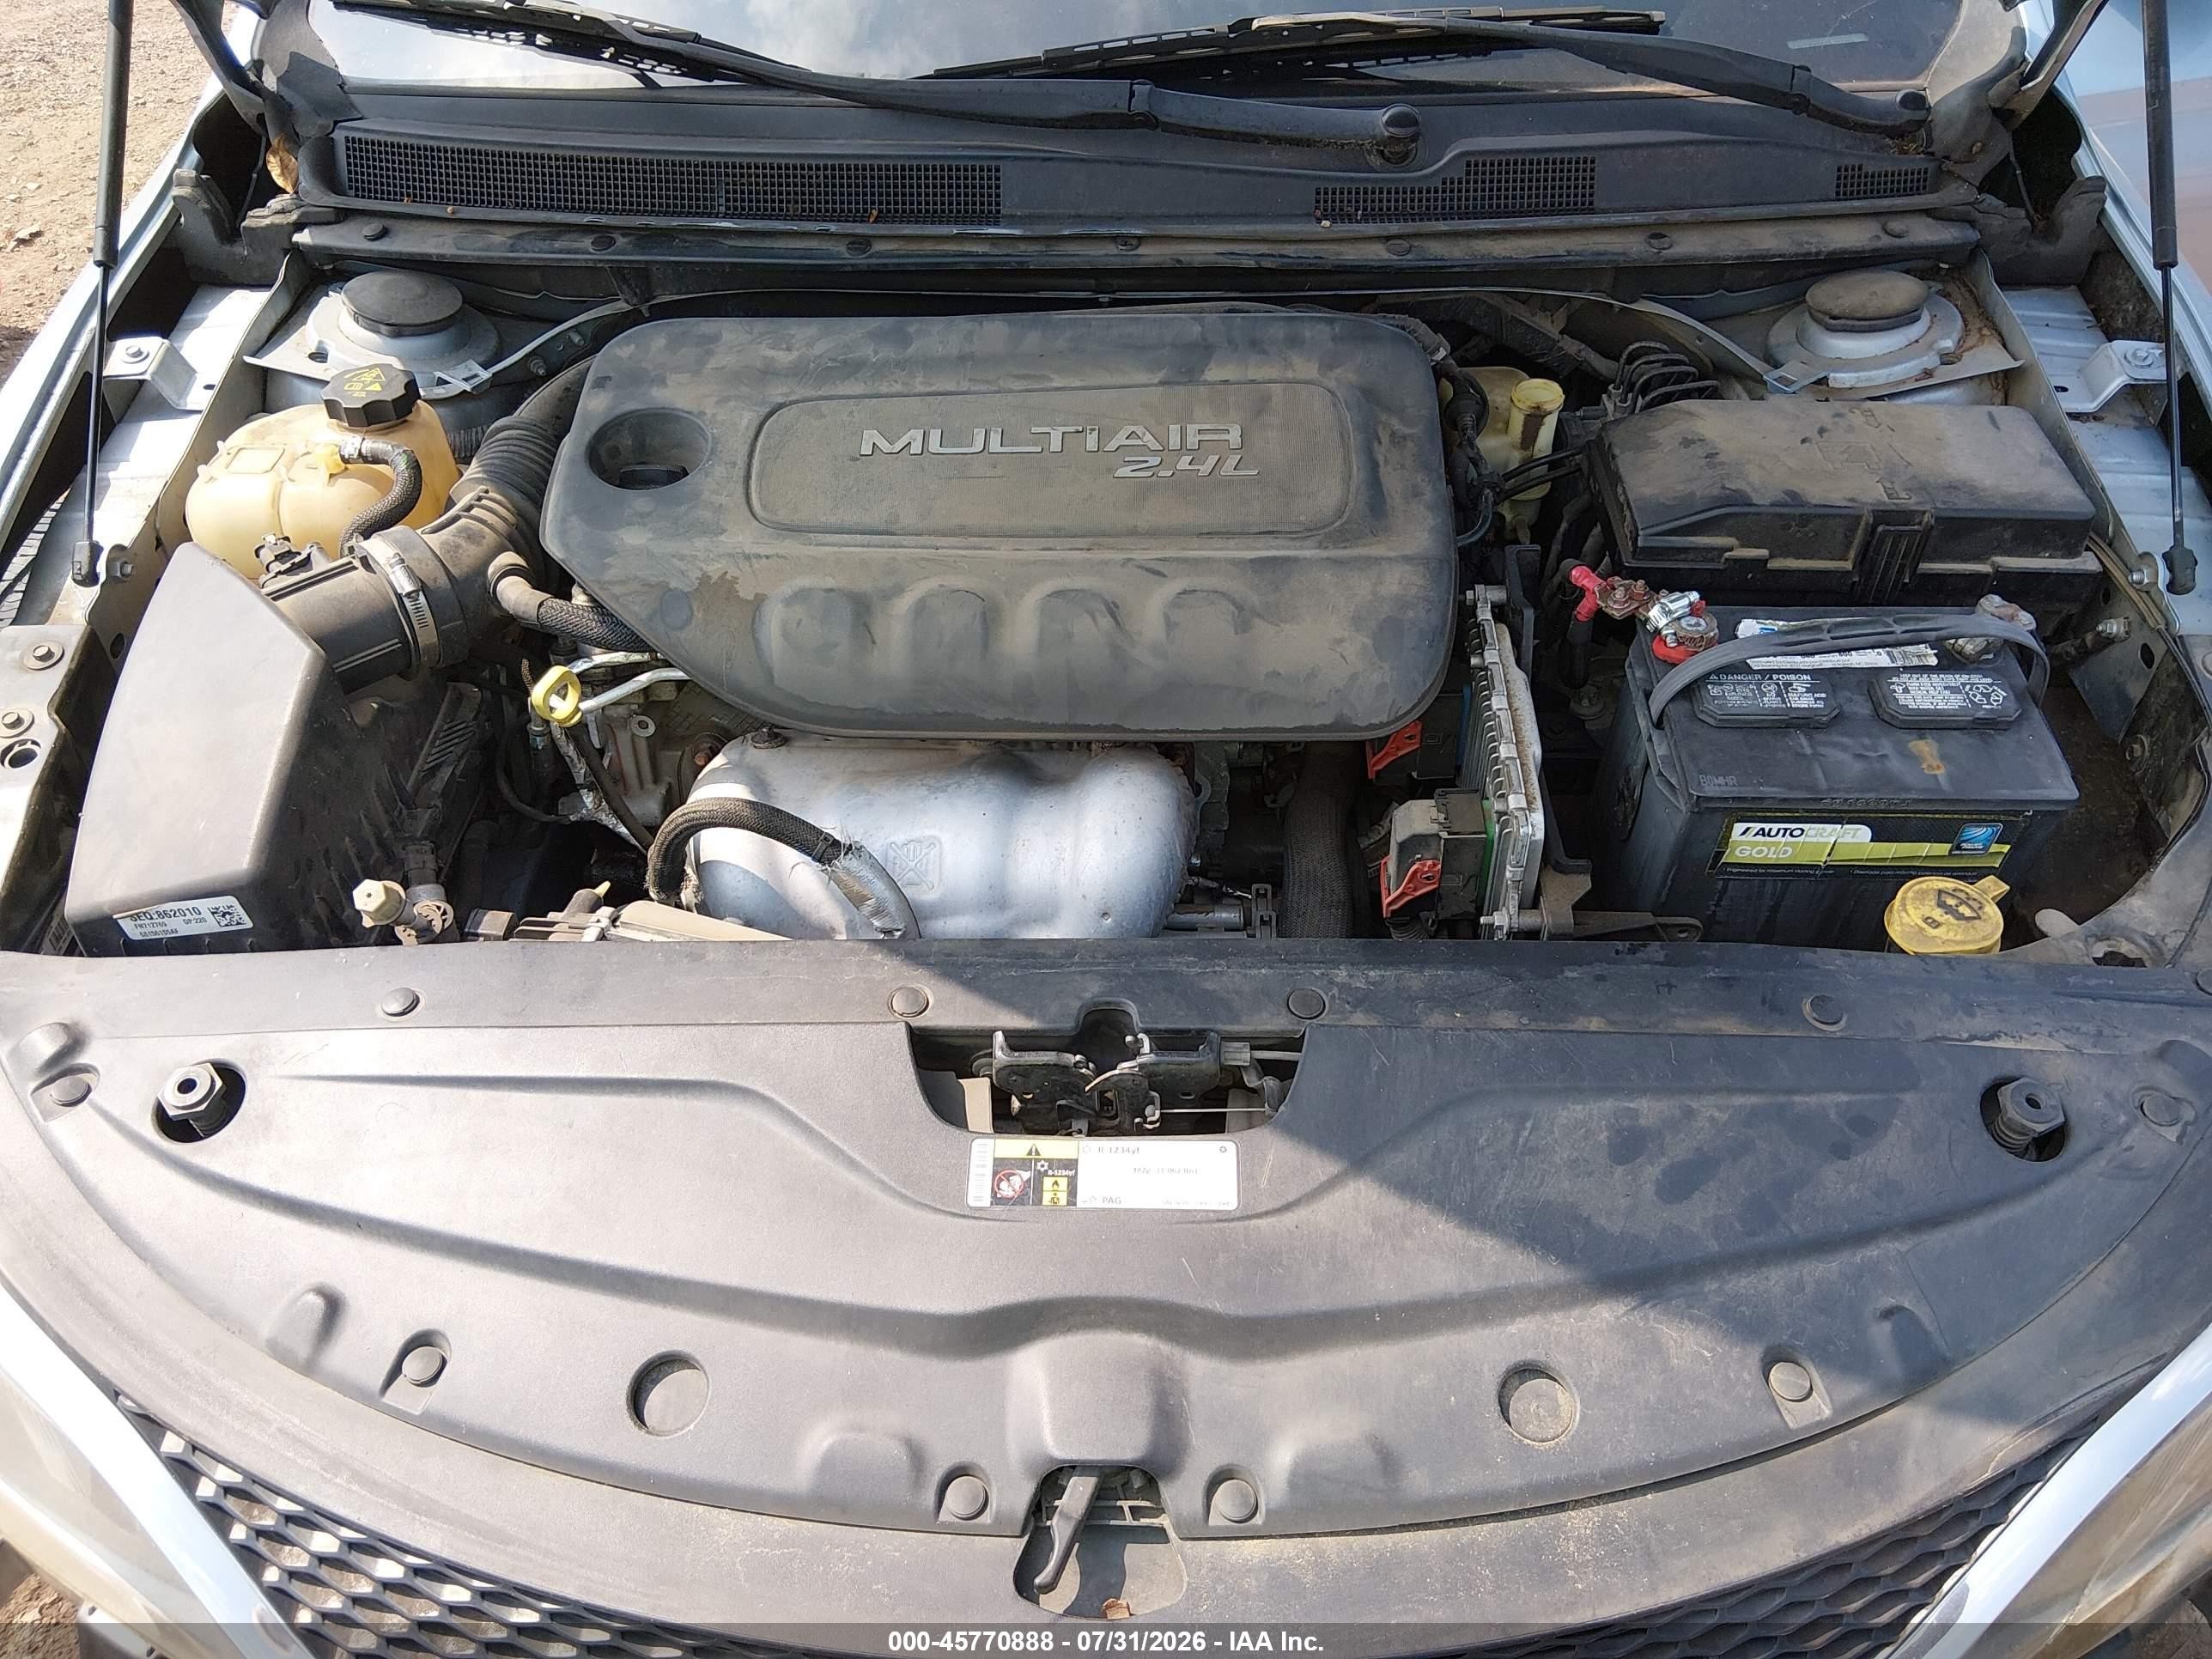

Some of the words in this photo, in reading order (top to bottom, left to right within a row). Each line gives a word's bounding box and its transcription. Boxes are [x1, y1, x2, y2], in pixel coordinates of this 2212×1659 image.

[859, 424, 1243, 455] MULTIAIR
[1113, 453, 1260, 478] 2.4L
[1735, 846, 1793, 858] GOLD
[1102, 1196, 1121, 1205] PAG
